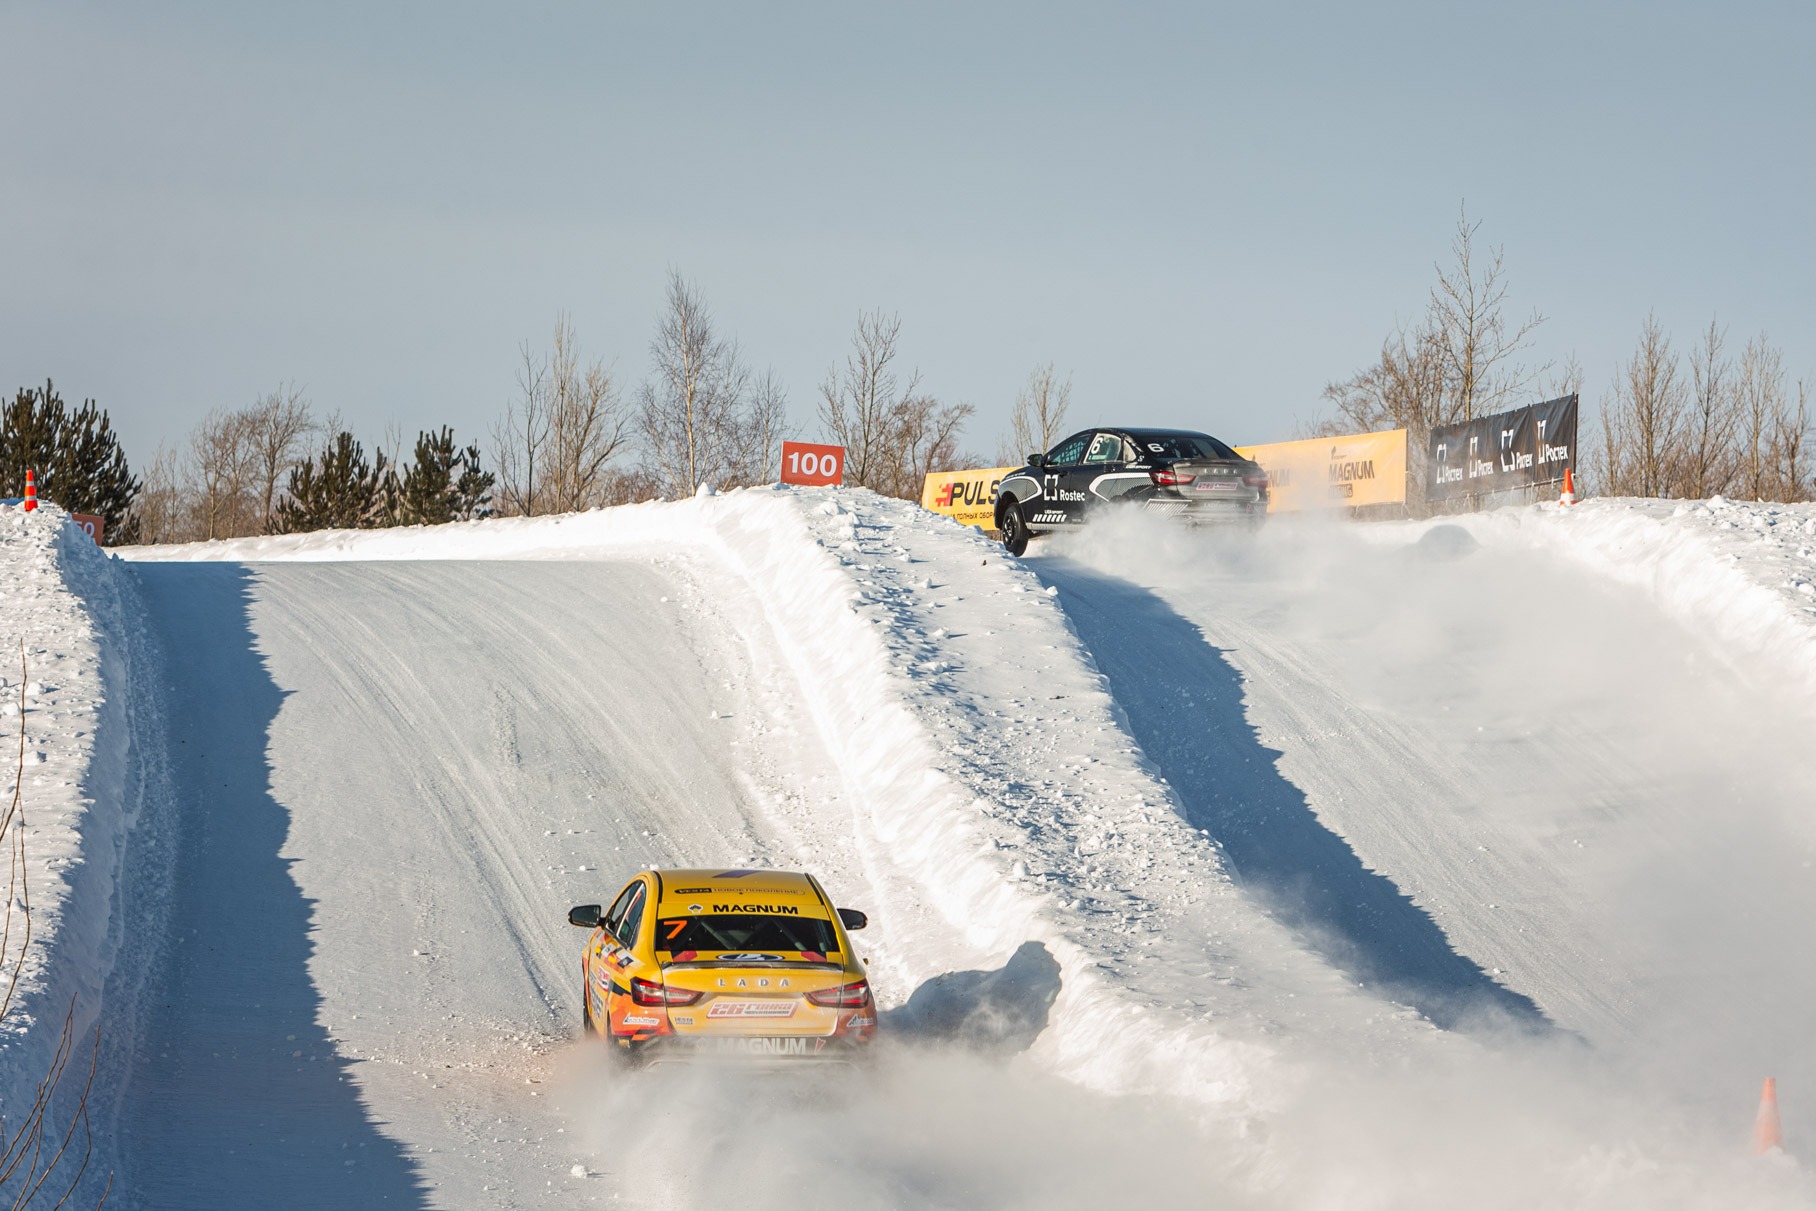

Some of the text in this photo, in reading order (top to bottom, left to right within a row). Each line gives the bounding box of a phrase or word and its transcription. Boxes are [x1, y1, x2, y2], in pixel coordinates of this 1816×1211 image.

[1091, 437, 1104, 454] 6
[1147, 443, 1165, 453] 6
[1546, 444, 1569, 462] Ростех
[788, 451, 837, 477] 100
[1328, 460, 1375, 481] MAGNUM
[1060, 489, 1085, 501] Rostec
[957, 512, 978, 520] ПОЛНЫХ
[713, 904, 799, 914] MAGNUM
[663, 920, 687, 940] 7
[718, 978, 789, 987] LADA
[711, 1003, 746, 1015] 26
[718, 1037, 807, 1055] MAGNUM
